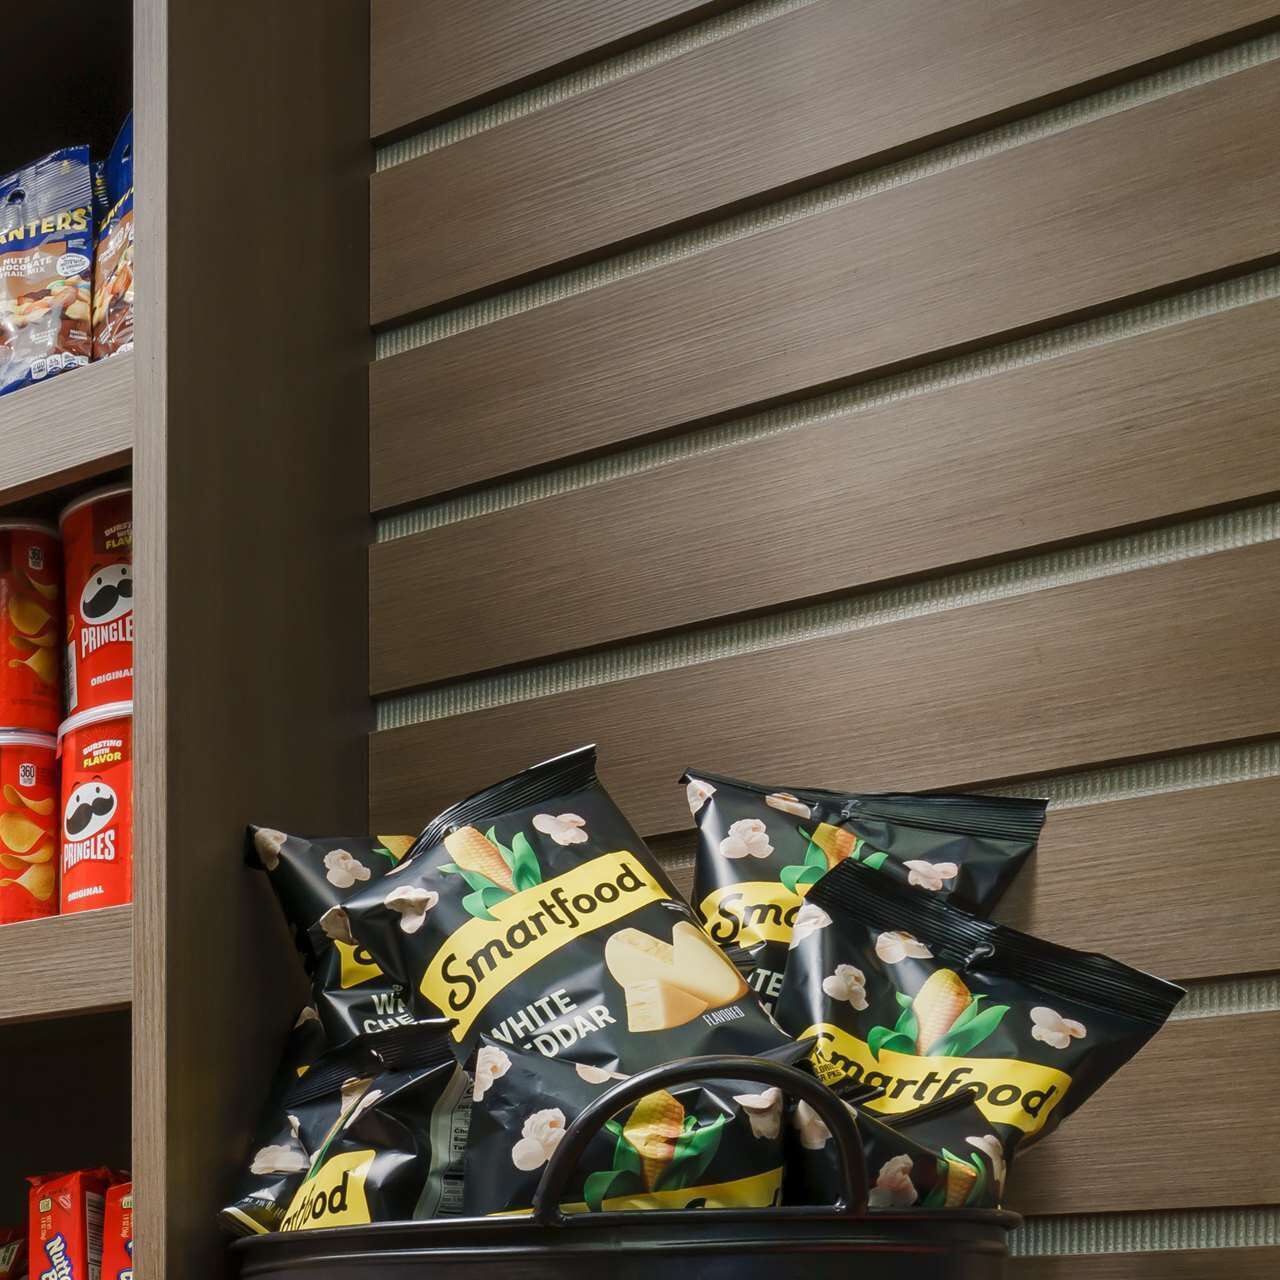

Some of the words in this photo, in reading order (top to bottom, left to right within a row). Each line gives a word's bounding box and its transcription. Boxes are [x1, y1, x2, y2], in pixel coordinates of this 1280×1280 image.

[3, 255, 27, 267] NUTS
[27, 264, 45, 275] MIX
[84, 752, 121, 768] FLAVOR
[21, 765, 35, 778] 360
[441, 862, 648, 1011] Smartfood
[702, 1006, 745, 1027] FLAVORED
